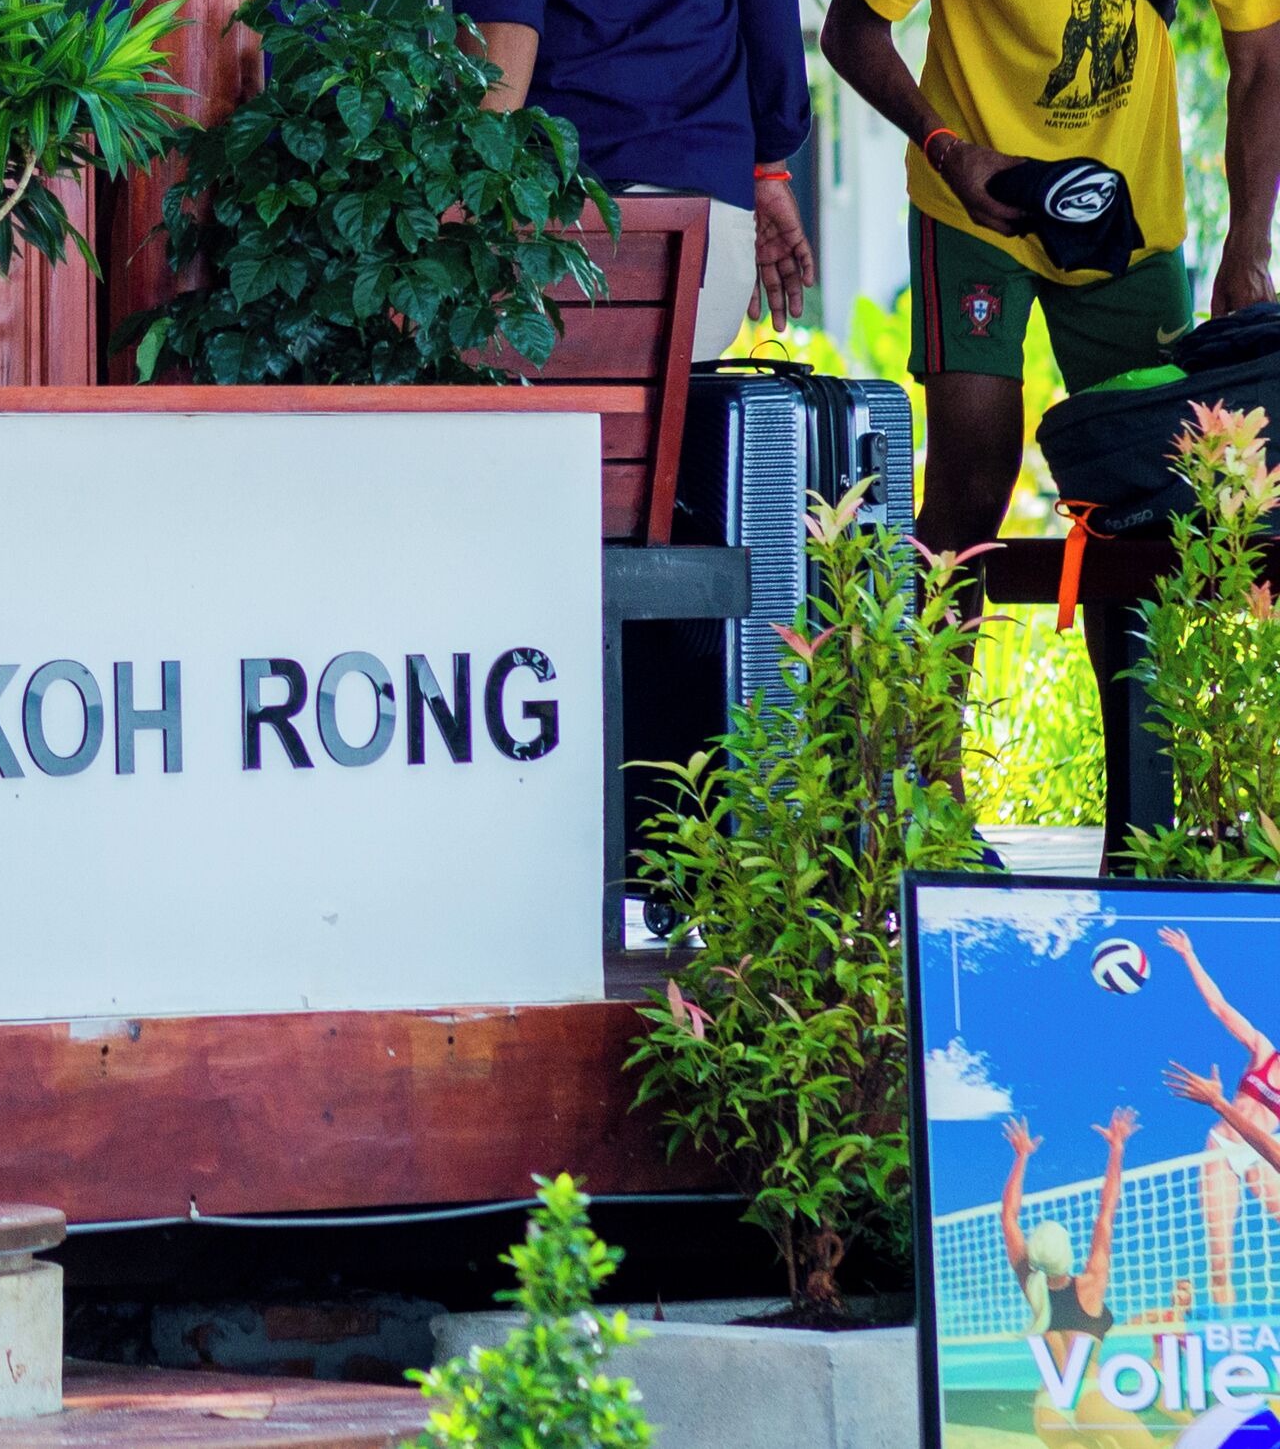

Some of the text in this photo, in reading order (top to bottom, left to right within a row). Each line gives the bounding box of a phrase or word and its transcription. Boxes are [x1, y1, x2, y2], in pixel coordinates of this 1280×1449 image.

[240, 647, 560, 772] RONG
[1027, 1334, 1280, 1412] Volle
[1205, 1323, 1280, 1352] BEA
